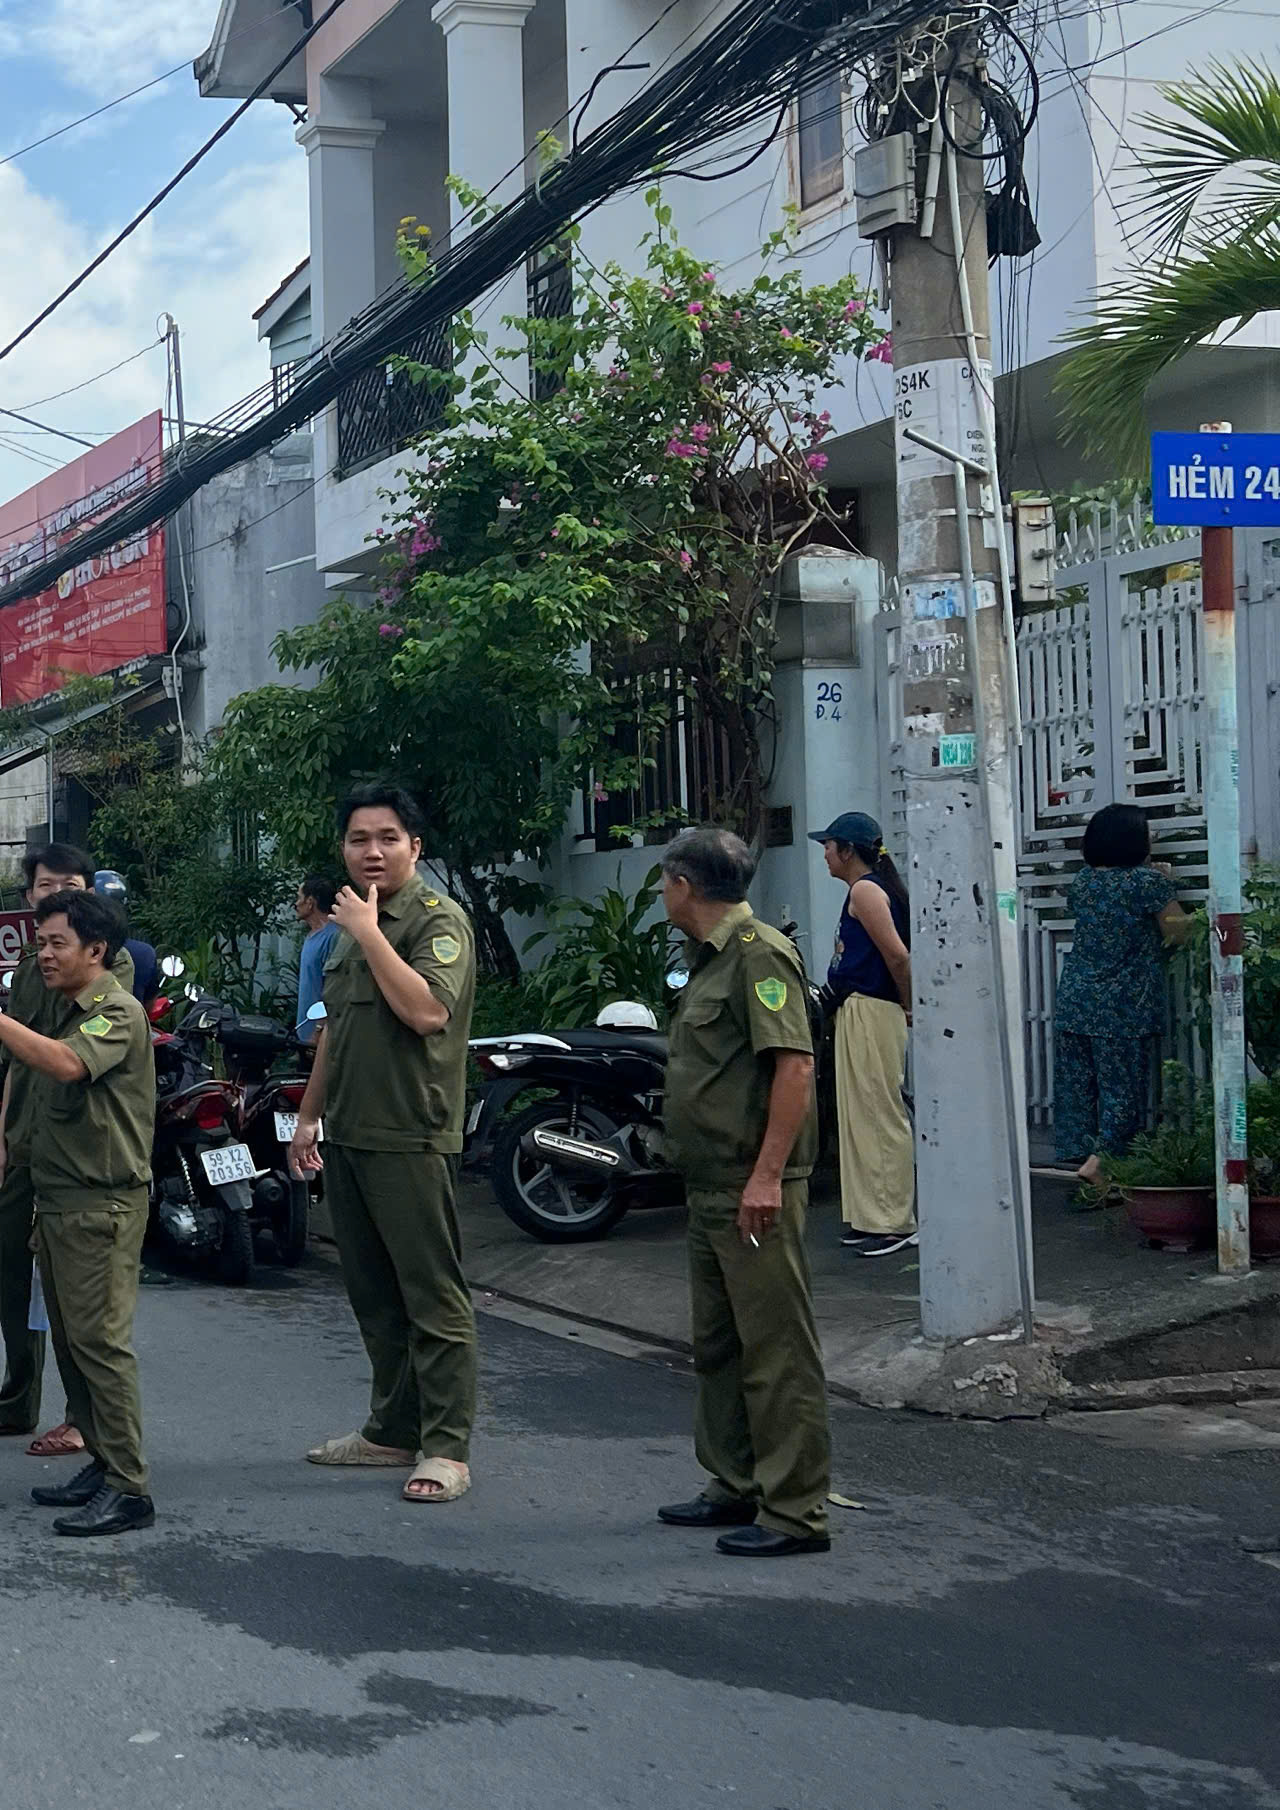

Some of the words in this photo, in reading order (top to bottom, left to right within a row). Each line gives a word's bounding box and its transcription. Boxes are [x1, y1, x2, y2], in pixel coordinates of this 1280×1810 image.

[1168, 453, 1235, 499] HẺM
[816, 682, 843, 703] 26
[208, 1148, 244, 1168] 59-X2
[209, 1161, 252, 1183] 203.56
